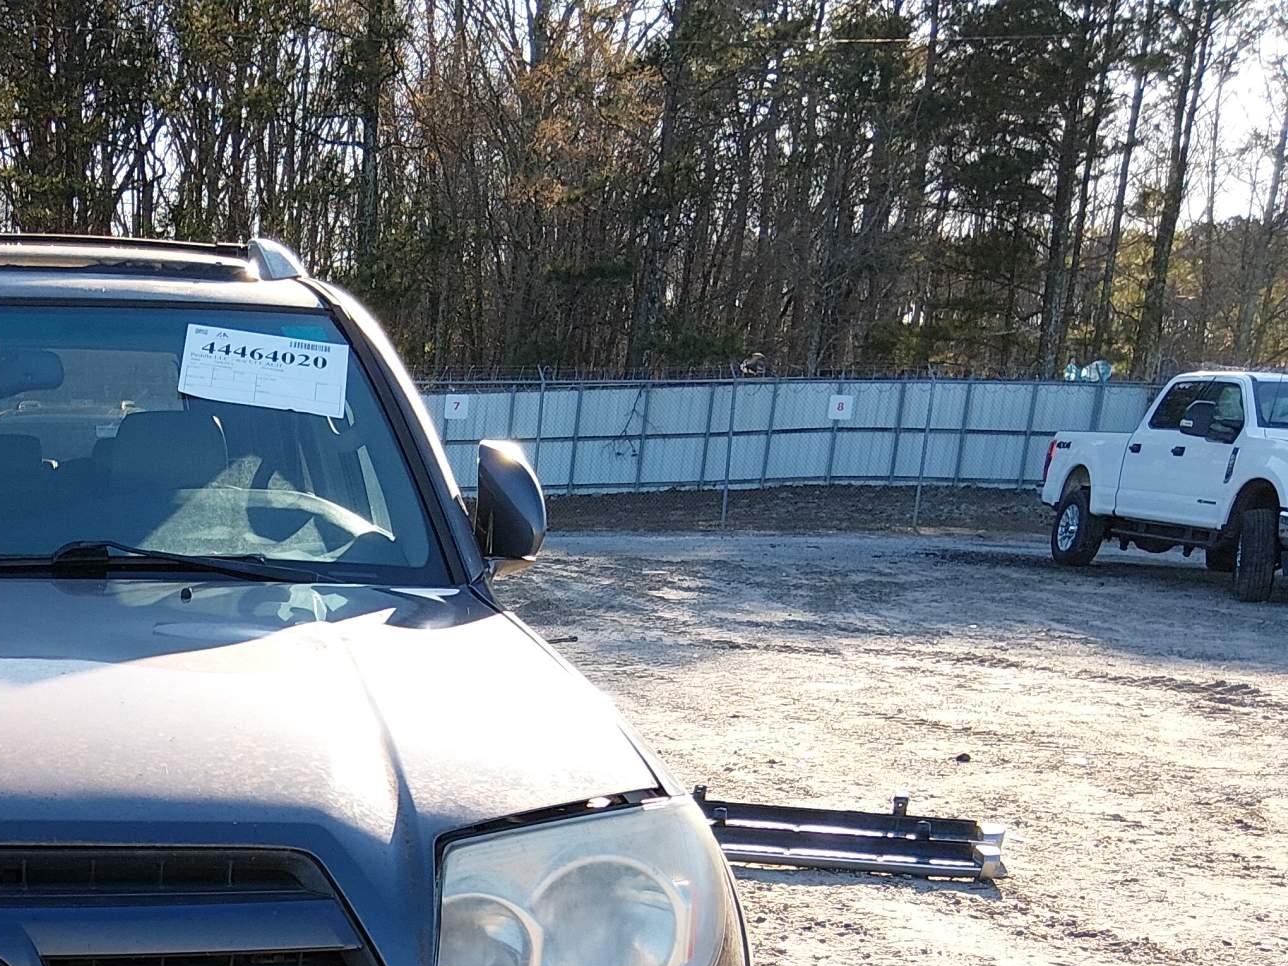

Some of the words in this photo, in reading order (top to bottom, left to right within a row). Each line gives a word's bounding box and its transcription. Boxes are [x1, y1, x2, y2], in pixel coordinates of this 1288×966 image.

[201, 341, 327, 369] 44464020
[453, 401, 461, 410] 7
[837, 402, 844, 411] 8
